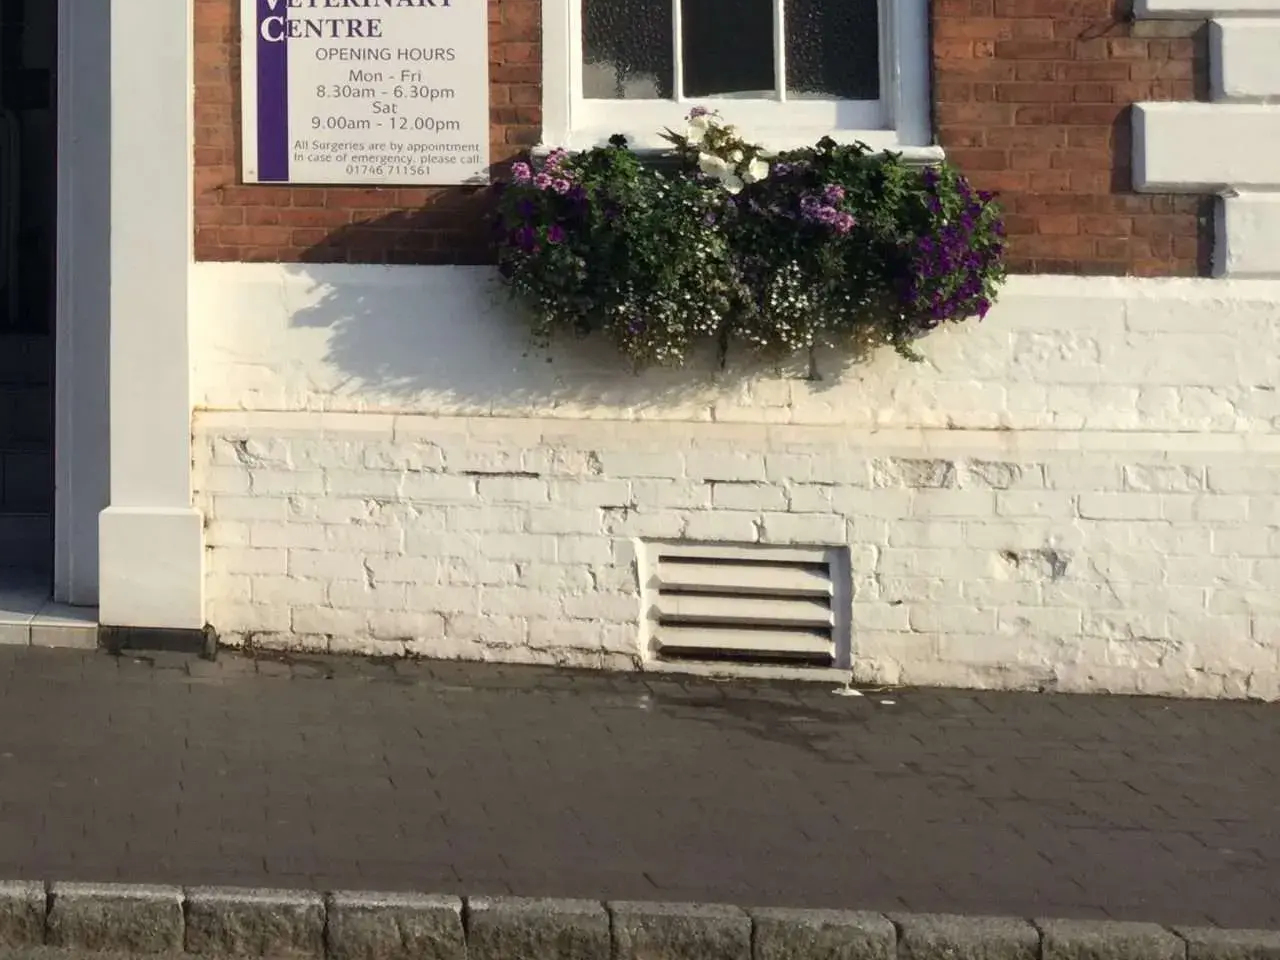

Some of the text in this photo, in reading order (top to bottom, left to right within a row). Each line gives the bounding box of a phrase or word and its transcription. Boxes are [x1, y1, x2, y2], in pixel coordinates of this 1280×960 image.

[260, 15, 383, 42] CENTRE
[315, 47, 456, 62] OPENING HOURS
[348, 70, 383, 82] Mon
[400, 70, 422, 82] Fri
[316, 85, 376, 98] 8.30am
[393, 85, 455, 102] 6.30pm
[372, 101, 398, 114] Sat
[311, 116, 370, 130] 9.00am
[389, 116, 460, 133] 12.00pm
[294, 140, 480, 153] All Surgeries are by appointment
[294, 152, 304, 161] In
[307, 154, 331, 162] case
[336, 153, 347, 162] of
[420, 155, 456, 166] please
